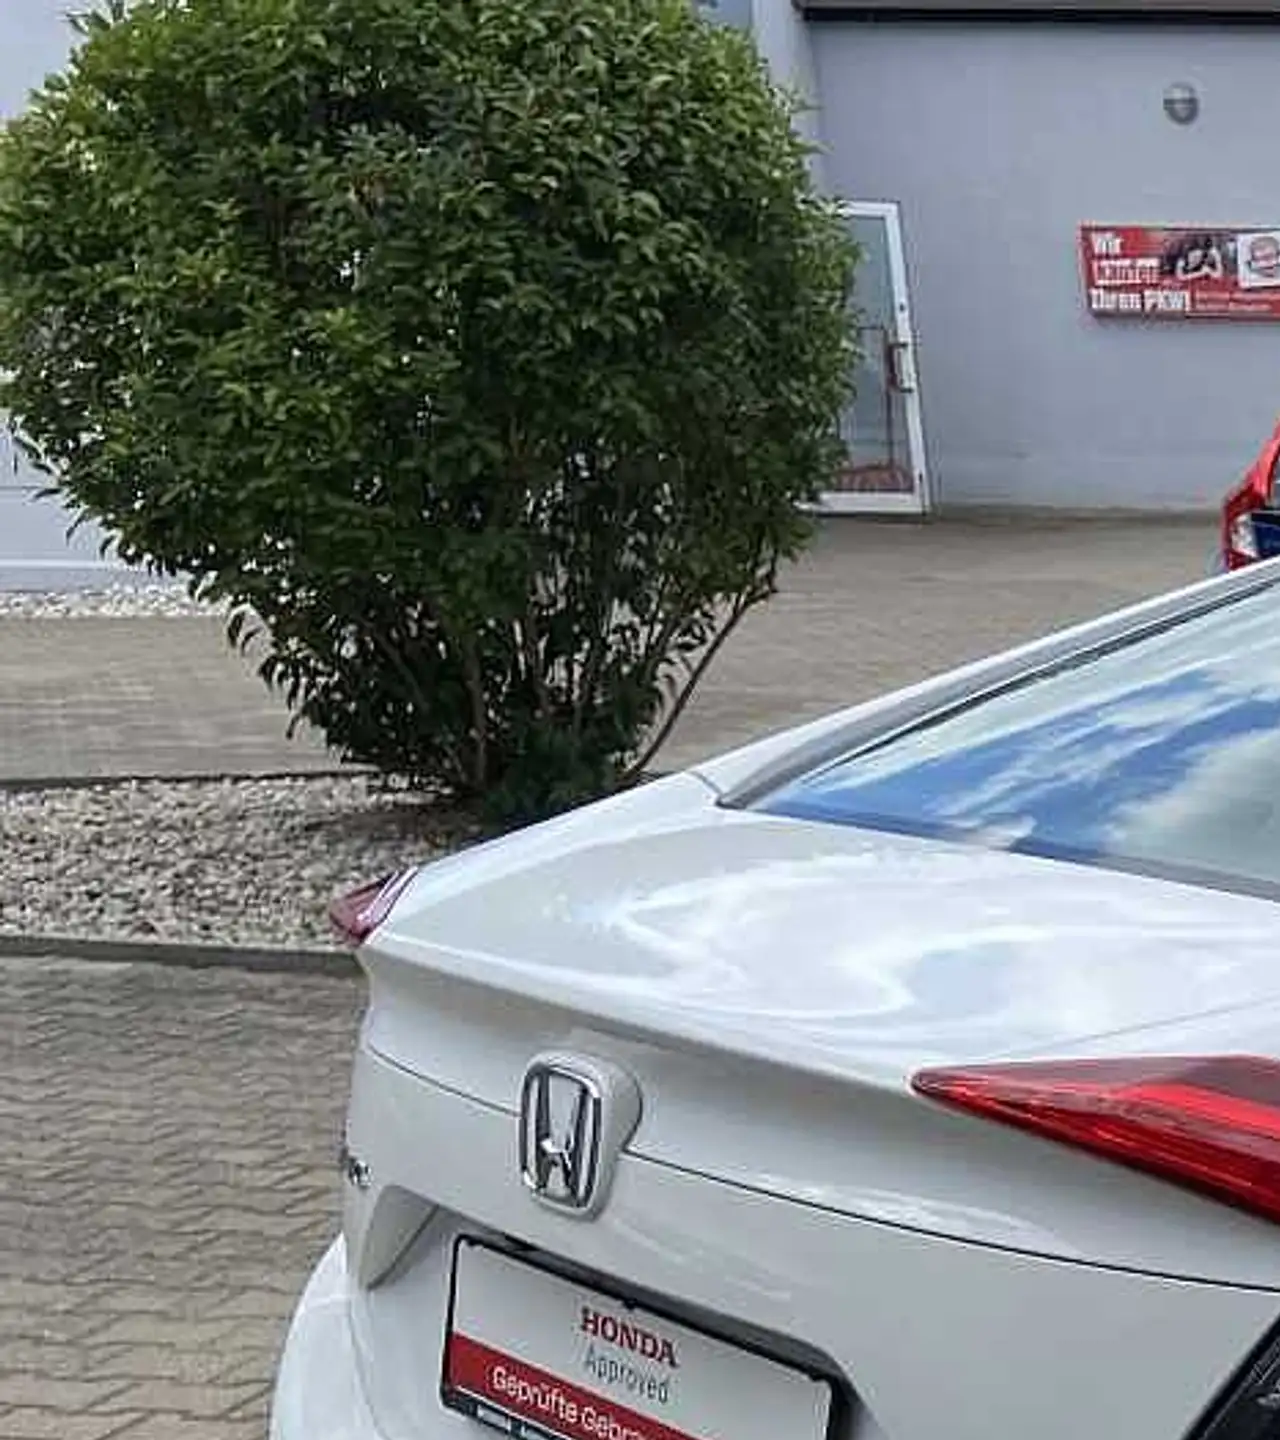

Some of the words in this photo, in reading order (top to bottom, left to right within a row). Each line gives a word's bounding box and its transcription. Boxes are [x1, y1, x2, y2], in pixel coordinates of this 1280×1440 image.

[580, 1306, 679, 1368] HONDA
[491, 1366, 578, 1423] Geprüfte
[584, 1344, 670, 1404] Approved
